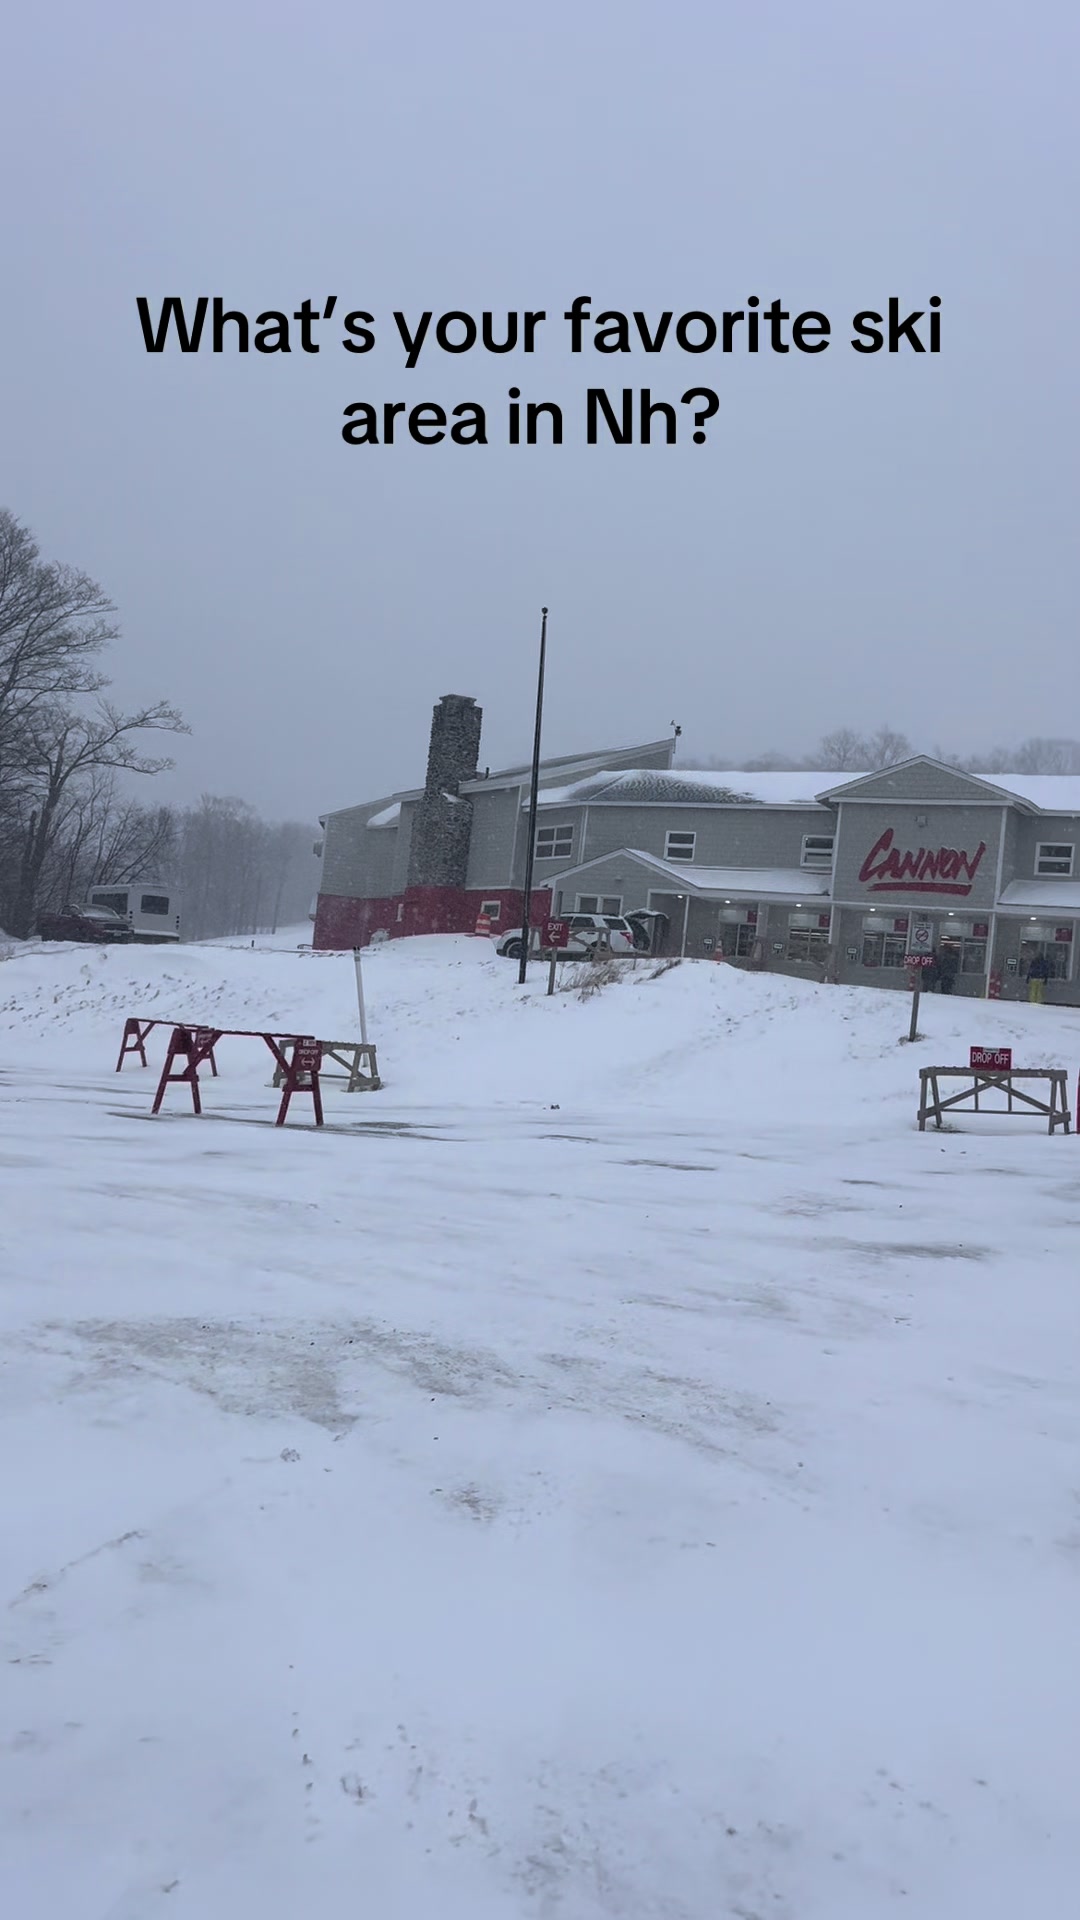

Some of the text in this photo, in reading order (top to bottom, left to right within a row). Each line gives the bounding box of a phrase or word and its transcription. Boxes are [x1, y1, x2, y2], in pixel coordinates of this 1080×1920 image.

[858, 827, 986, 882] CANNON
[548, 922, 563, 931] EXIT
[904, 955, 933, 966] DROP OFF
[971, 1051, 1009, 1065] DROP OFF
